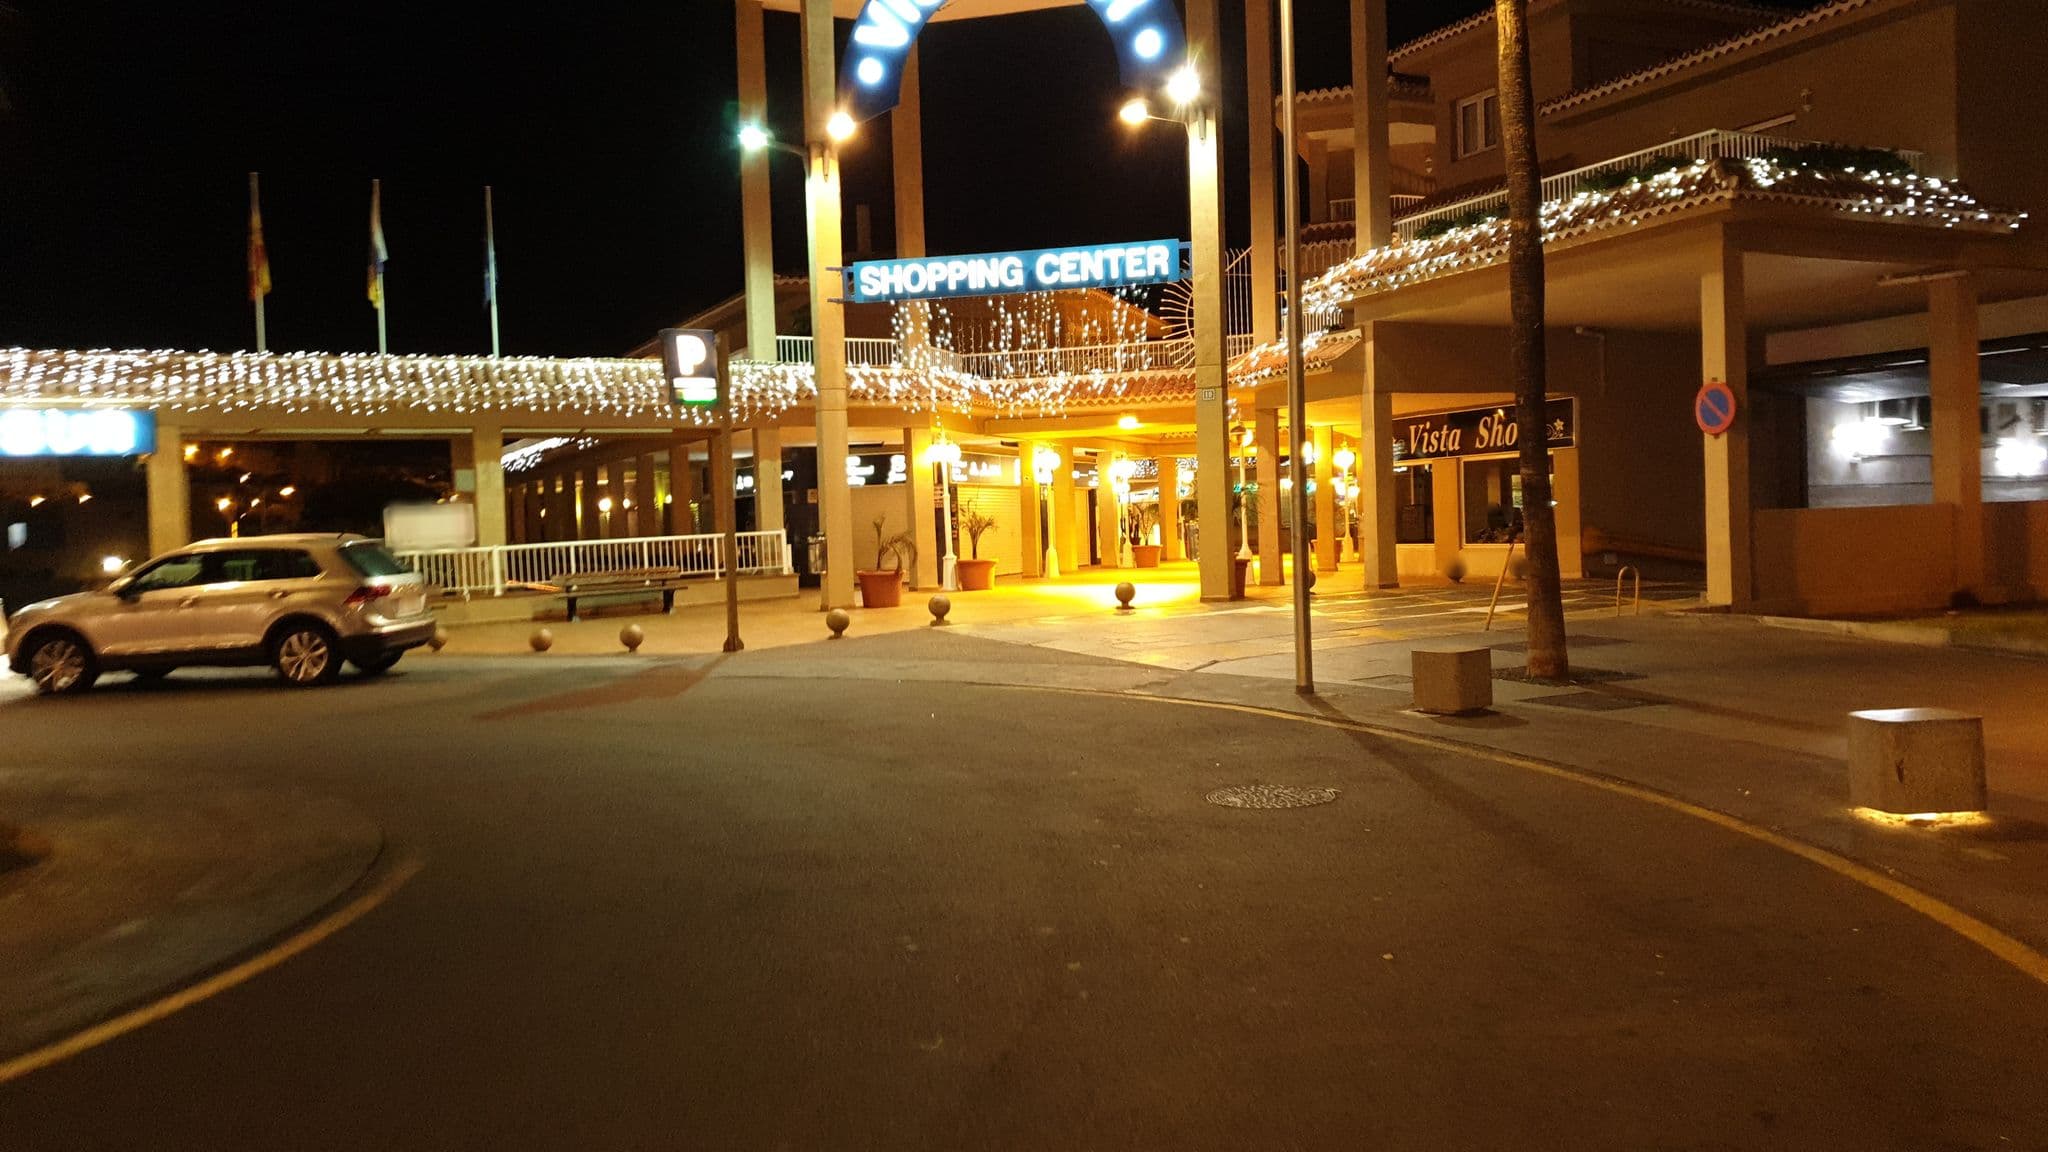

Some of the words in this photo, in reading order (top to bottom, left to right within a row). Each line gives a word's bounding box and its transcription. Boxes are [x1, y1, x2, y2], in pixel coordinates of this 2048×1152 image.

[860, 256, 1024, 297] SHOPPING
[1035, 244, 1170, 285] CENTER
[1409, 421, 1461, 455] Vista
[1475, 412, 1519, 449] Sho
